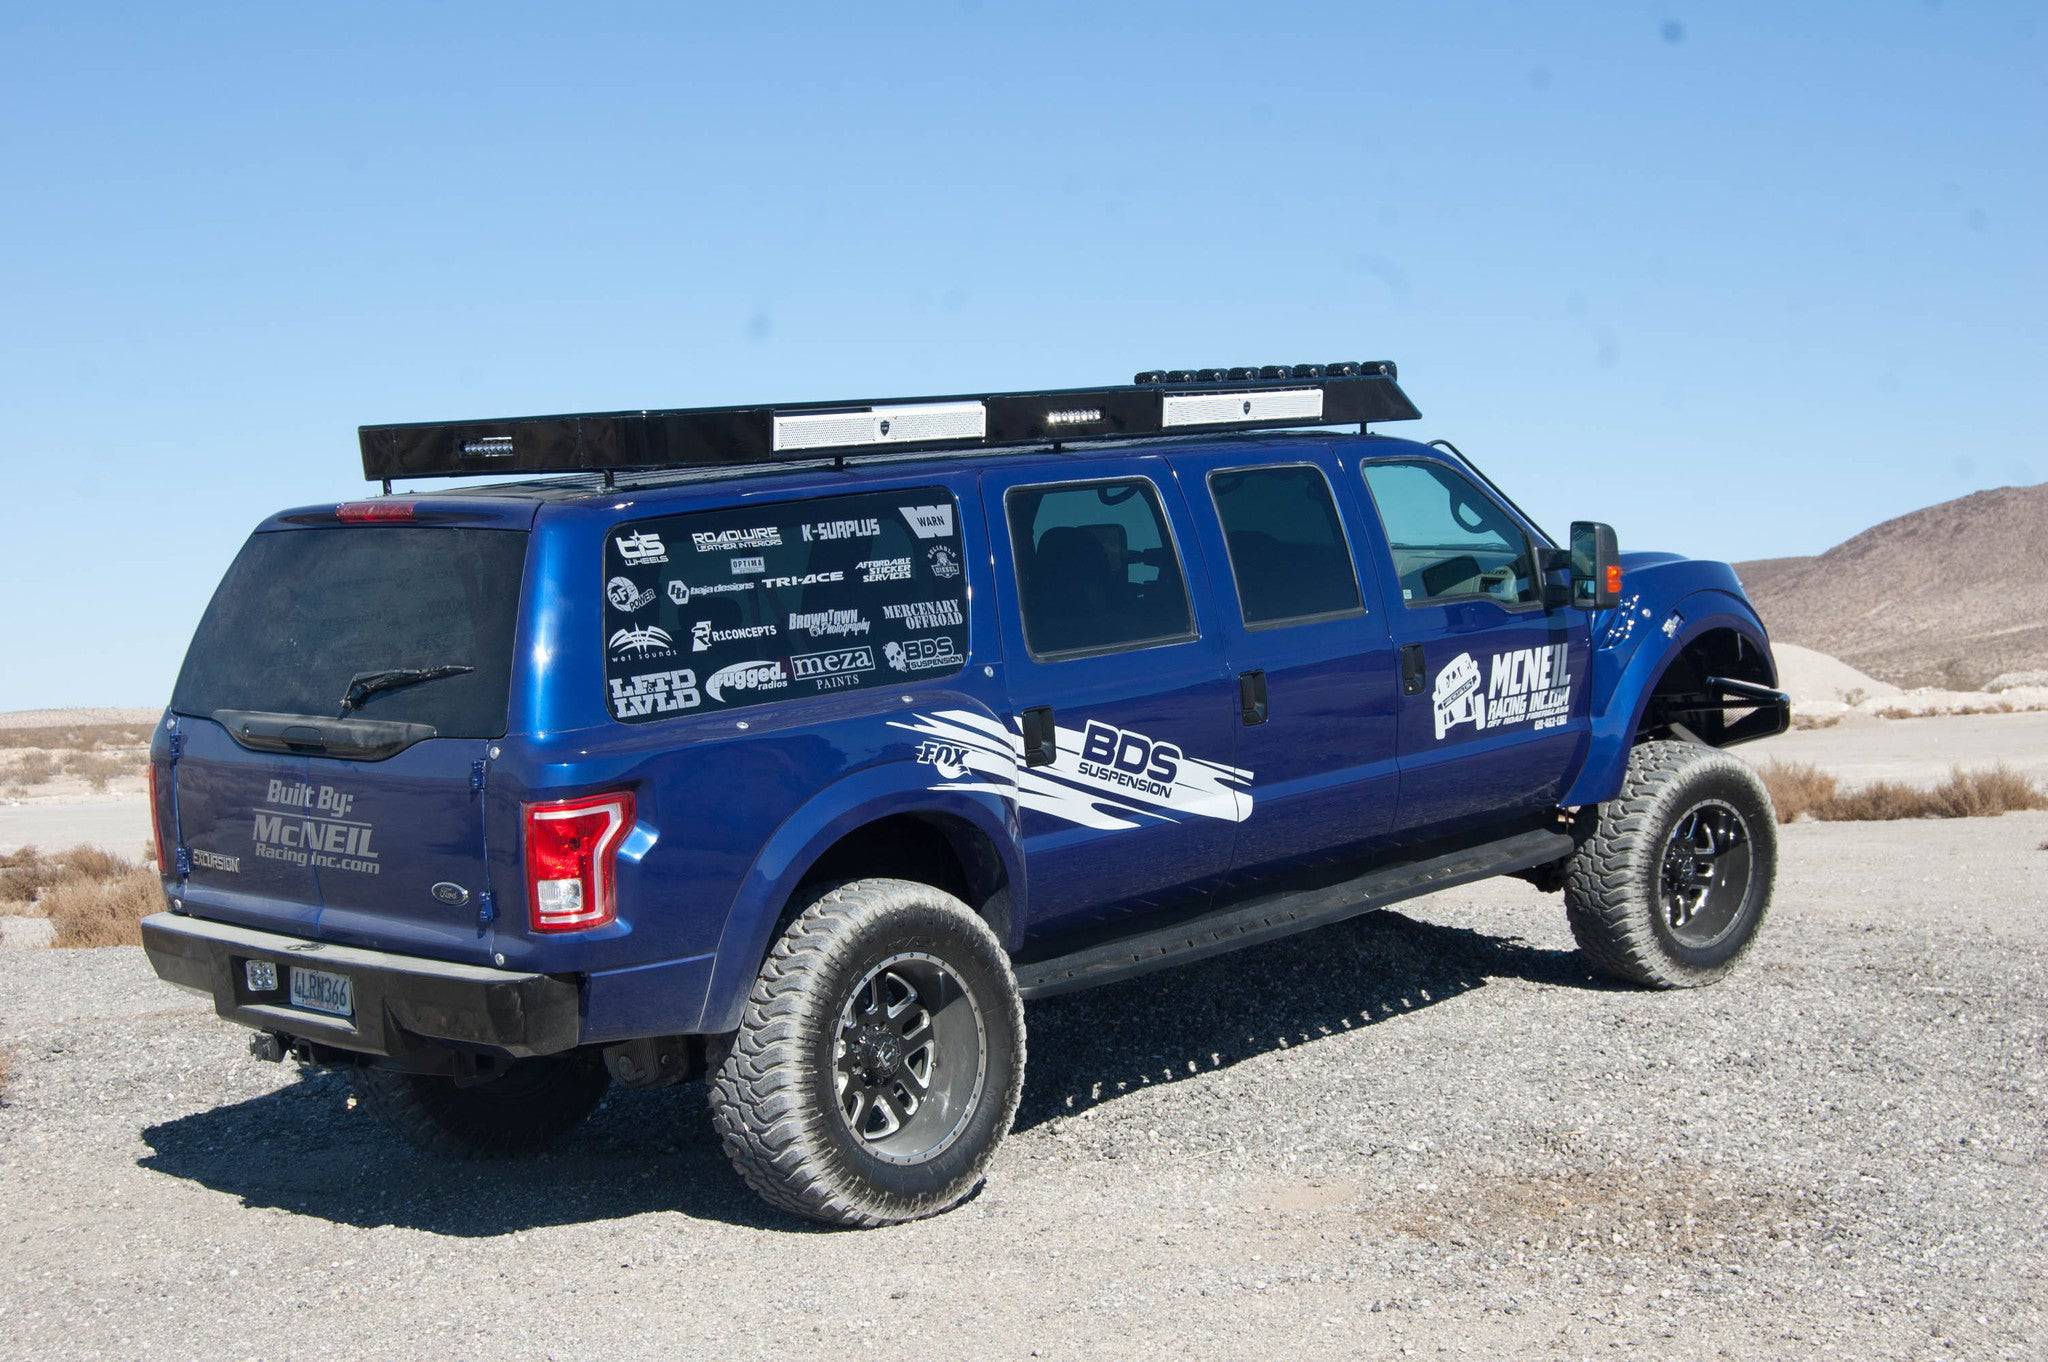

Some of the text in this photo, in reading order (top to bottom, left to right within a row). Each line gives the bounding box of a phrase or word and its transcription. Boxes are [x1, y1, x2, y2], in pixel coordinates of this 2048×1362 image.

[801, 518, 880, 542] K-SURPLUS
[917, 515, 945, 527] WARN
[692, 526, 780, 545] ROADWIRE
[695, 539, 783, 552] LEATHER INTERIORS
[625, 555, 669, 566] WHEELS
[732, 559, 763, 569] OPTIMA
[855, 557, 911, 570] AFFORDABLE
[869, 564, 911, 575] STICKER
[762, 571, 845, 589] TRI-ACE
[862, 571, 911, 583] SERVICES
[714, 582, 754, 593] designs
[629, 589, 656, 611] POWER
[882, 599, 959, 620] MERCENARY
[905, 612, 963, 630] OFFROAD
[611, 649, 678, 663] wet sounds
[903, 636, 955, 662] BDS
[793, 648, 872, 676] meza
[909, 654, 964, 671] SUSPENSION
[757, 680, 788, 691] radios
[816, 674, 860, 690] PAINTS
[613, 687, 701, 719] LVLD
[1487, 694, 1528, 721] RACING
[1486, 718, 1503, 729] OFF
[1503, 714, 1525, 725] ROAD
[915, 740, 971, 768] FOX
[1080, 722, 1182, 784] BDS
[1078, 762, 1173, 799] SUSPENSION
[266, 779, 354, 818] Built By:
[253, 813, 379, 859] McNEIL
[255, 842, 307, 868] Racing
